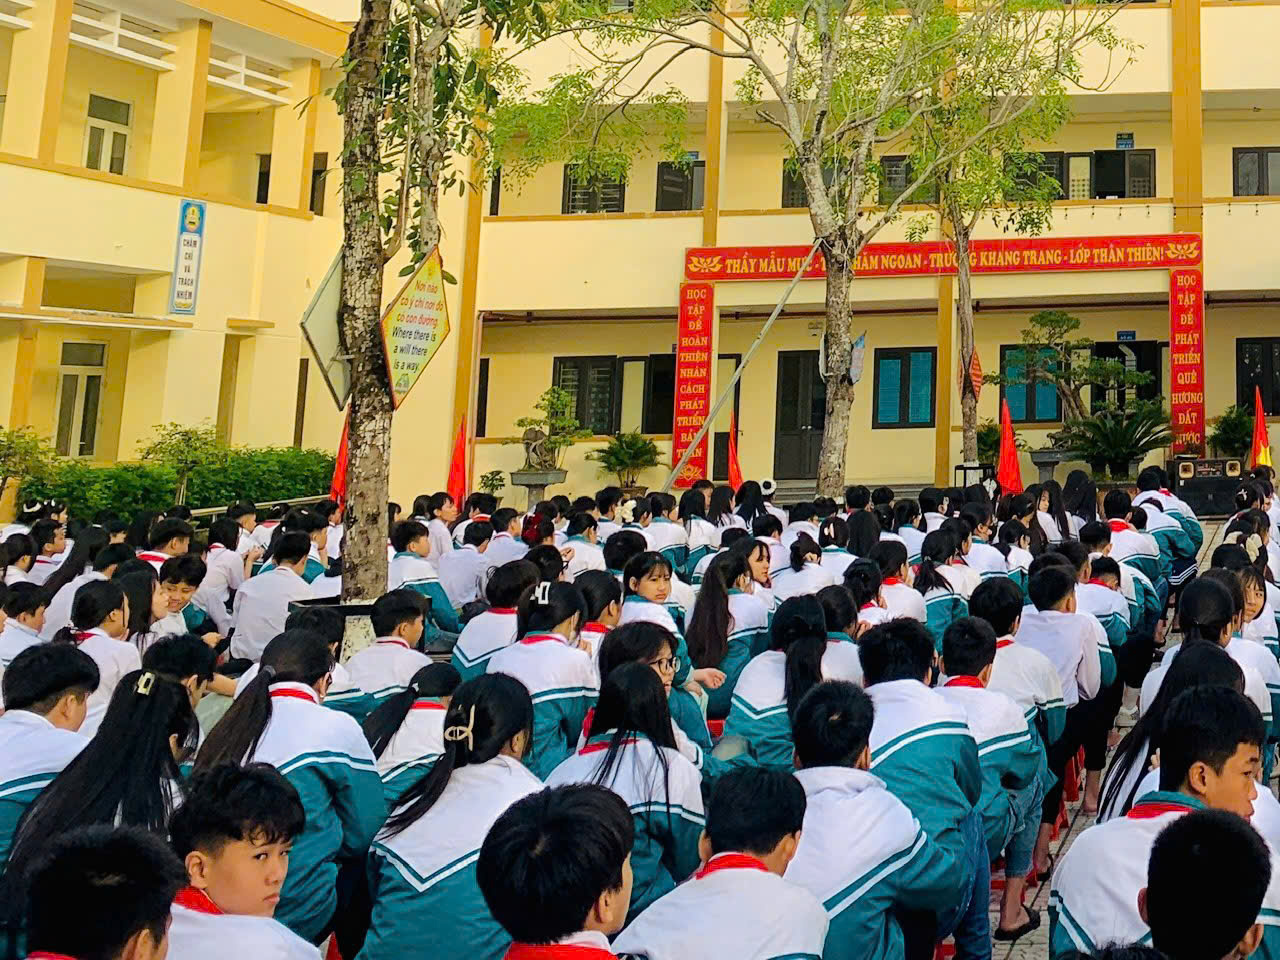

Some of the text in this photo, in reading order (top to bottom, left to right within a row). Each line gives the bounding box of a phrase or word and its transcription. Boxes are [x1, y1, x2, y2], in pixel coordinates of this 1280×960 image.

[726, 251, 760, 273] THẦY
[759, 250, 785, 272] MẪU
[852, 251, 878, 270] HĂM
[881, 254, 921, 270] NGOAN
[929, 250, 977, 268] TRƯG
[980, 250, 1020, 265] KHANG
[1022, 249, 1062, 265] TRANG
[1069, 243, 1090, 264] LỚP
[1093, 243, 1124, 263] THÂN
[1127, 242, 1164, 265] THIỆN!
[1176, 275, 1197, 288] HỌC
[686, 289, 707, 300] HỌC
[1177, 291, 1196, 307] TẬP
[687, 304, 705, 316] TẬP
[392, 325, 437, 342] Where there is
[1174, 330, 1199, 344] PHÁT
[393, 343, 428, 357] a will there
[680, 350, 708, 363] THIỆN
[1172, 347, 1201, 364] TRIỂN
[393, 358, 400, 370] is
[400, 361, 406, 370] a
[680, 366, 707, 377] NHÂN
[1177, 368, 1197, 384] QUÊ
[680, 381, 705, 394] CÁCH
[679, 397, 705, 410] PHÁT
[1171, 391, 1203, 404] HƯƠNG
[1178, 408, 1197, 424] ĐẤT
